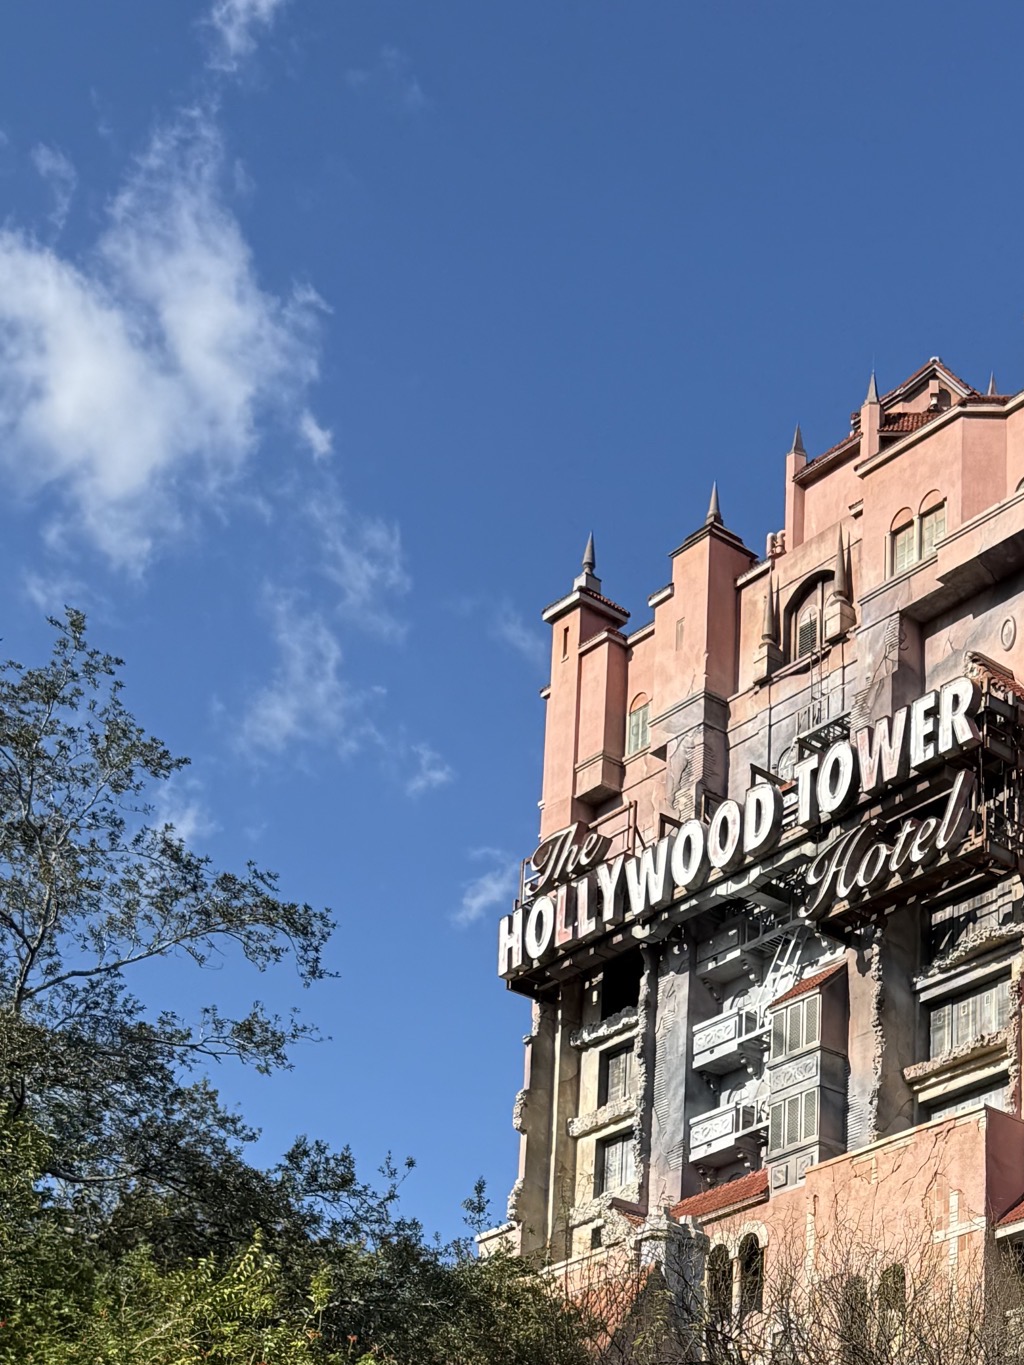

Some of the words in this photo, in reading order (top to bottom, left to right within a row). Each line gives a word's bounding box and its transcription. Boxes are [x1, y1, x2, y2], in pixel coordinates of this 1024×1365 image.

[497, 782, 780, 977] HOLLYWOOD
[794, 675, 982, 828] TOWER
[525, 821, 607, 897] The
[798, 768, 968, 918] Hotel
